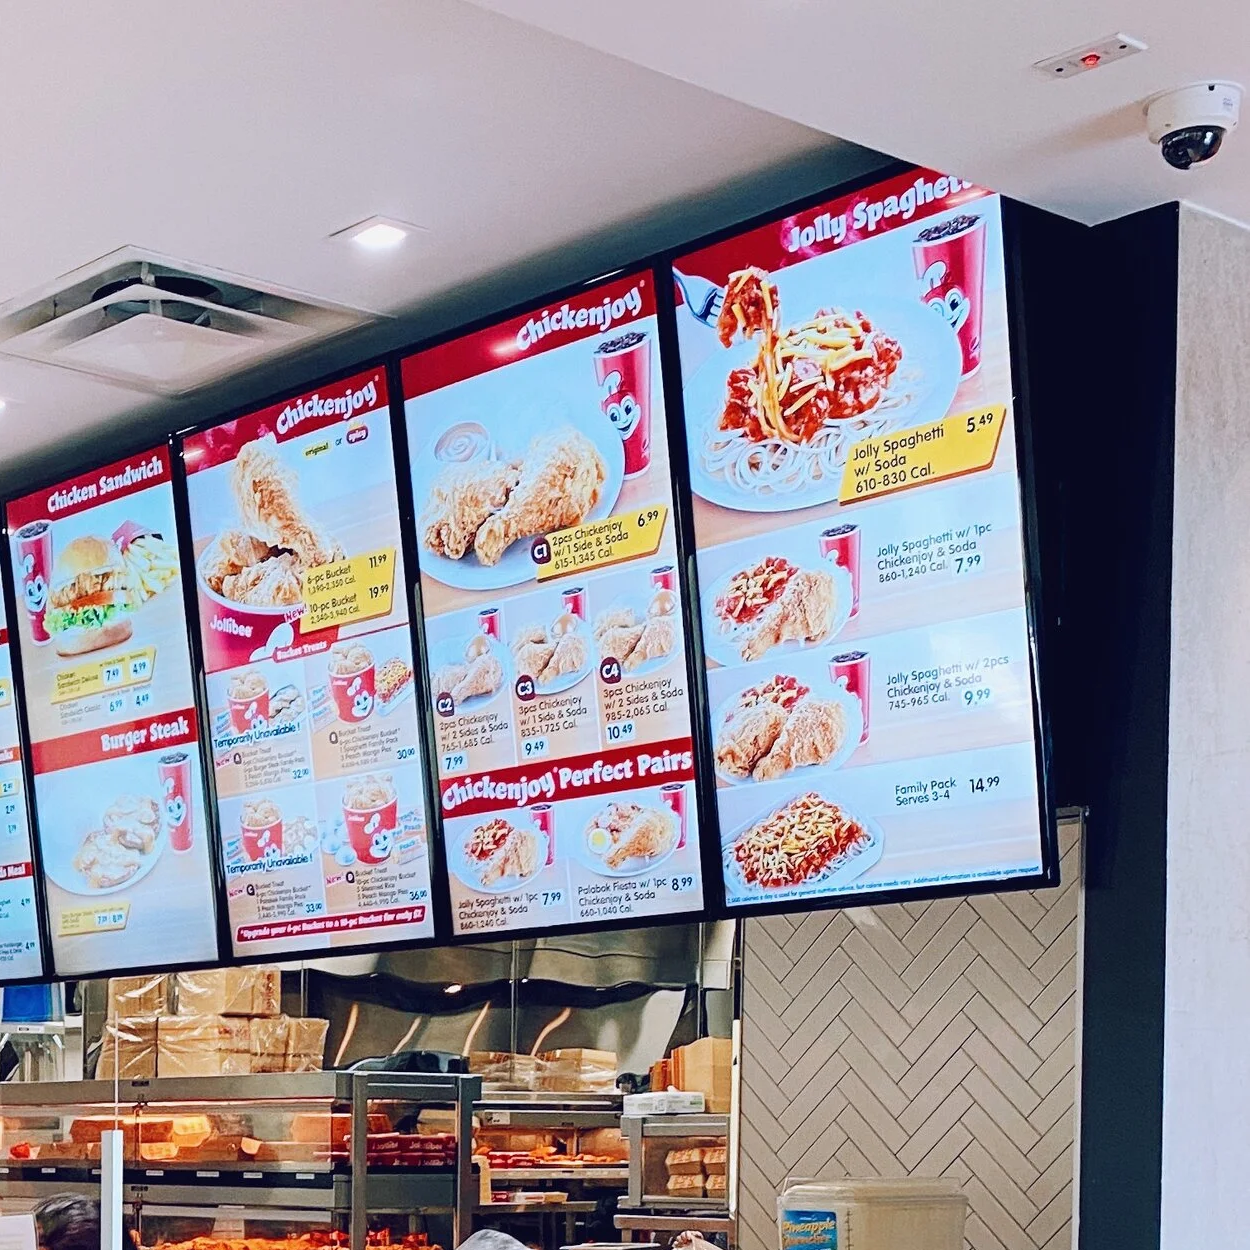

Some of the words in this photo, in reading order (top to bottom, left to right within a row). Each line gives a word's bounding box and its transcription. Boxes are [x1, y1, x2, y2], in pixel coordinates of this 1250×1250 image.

[788, 211, 848, 252] Jolly
[852, 175, 973, 232] Spaghet
[516, 285, 643, 350] Chickenjoy
[276, 380, 377, 435] Chickenjoy
[335, 437, 343, 446] or
[853, 444, 880, 461] Jolly
[883, 424, 944, 455] Spaghetti
[966, 413, 993, 433] 5.49
[854, 463, 870, 477] w/
[875, 455, 906, 472] Soda
[47, 482, 97, 513] Chicken
[99, 455, 163, 495] Sandwich
[855, 472, 907, 493] 610-830
[910, 462, 935, 479] Cal.
[552, 536, 573, 548] 2pcs
[574, 520, 623, 540] Chickenjoy
[637, 510, 658, 528] 6.99
[877, 543, 899, 557] Jolly
[902, 529, 953, 552] Spaghetti
[955, 527, 970, 538] w/
[974, 523, 992, 538] 1pc
[534, 545, 548, 559] C1
[553, 546, 566, 557] w/
[573, 540, 593, 553] Side
[595, 537, 603, 546] &
[605, 532, 629, 544] Soda
[877, 550, 934, 570] Chickenjoy
[937, 545, 945, 556] &
[949, 540, 977, 555] Soda
[326, 565, 351, 579] Bucket
[369, 554, 387, 568] 11.99
[555, 553, 596, 570] 615-1,345
[598, 547, 614, 559] Cal.
[879, 564, 927, 583] 860-1,240
[930, 560, 948, 572] Cal.
[955, 555, 981, 573] 7.99
[310, 602, 330, 614] 10-pc
[331, 593, 357, 607] Bucket
[369, 584, 389, 599] 19.99
[210, 615, 253, 637] Jollibee
[602, 663, 619, 679] C4
[887, 672, 908, 686] Jolly
[911, 663, 962, 683] Spaghetti
[965, 658, 979, 671] w/
[983, 655, 1009, 669] 2pcs
[517, 681, 532, 695] C3
[603, 688, 623, 700] 3pcs
[625, 678, 672, 694] Chickenjoy
[626, 694, 649, 706] Sides
[651, 692, 658, 701] &
[660, 687, 684, 698] Soda
[887, 680, 941, 699] Chickenjoy
[943, 679, 952, 688] &
[955, 674, 982, 687] Soda
[438, 698, 452, 712] C2
[538, 695, 582, 711] Chickenjoy
[888, 695, 929, 711] 745-965
[931, 692, 950, 703] Cal.
[964, 688, 991, 706] 9.99
[458, 713, 498, 726] Chickenjoy
[538, 711, 555, 722] Side
[558, 710, 564, 718] &
[566, 706, 587, 717] Soda
[101, 728, 148, 752] Burger
[150, 716, 190, 742] Steak
[481, 725, 487, 734] &
[489, 721, 509, 732] Soda
[607, 723, 633, 740] 10.49
[525, 741, 544, 755] 9.49
[445, 756, 463, 770] 7.99
[442, 771, 556, 810] Chickenjoy
[559, 758, 634, 789] Perfect
[636, 749, 693, 777] Pairs
[895, 782, 927, 796] Family
[931, 777, 957, 790] Pack
[969, 776, 1000, 794] 14.99
[895, 794, 929, 806] Serves
[932, 790, 950, 801] 3-4
[7, 863, 26, 878] Meal
[578, 883, 611, 895] Palabok
[613, 881, 637, 891] Fiesta
[671, 877, 693, 891] 8.99
[509, 905, 528, 914] Soda
[542, 892, 561, 906] 7.99
[579, 894, 623, 906] Chickenjoy
[625, 893, 631, 901] &
[634, 891, 655, 901] Soda
